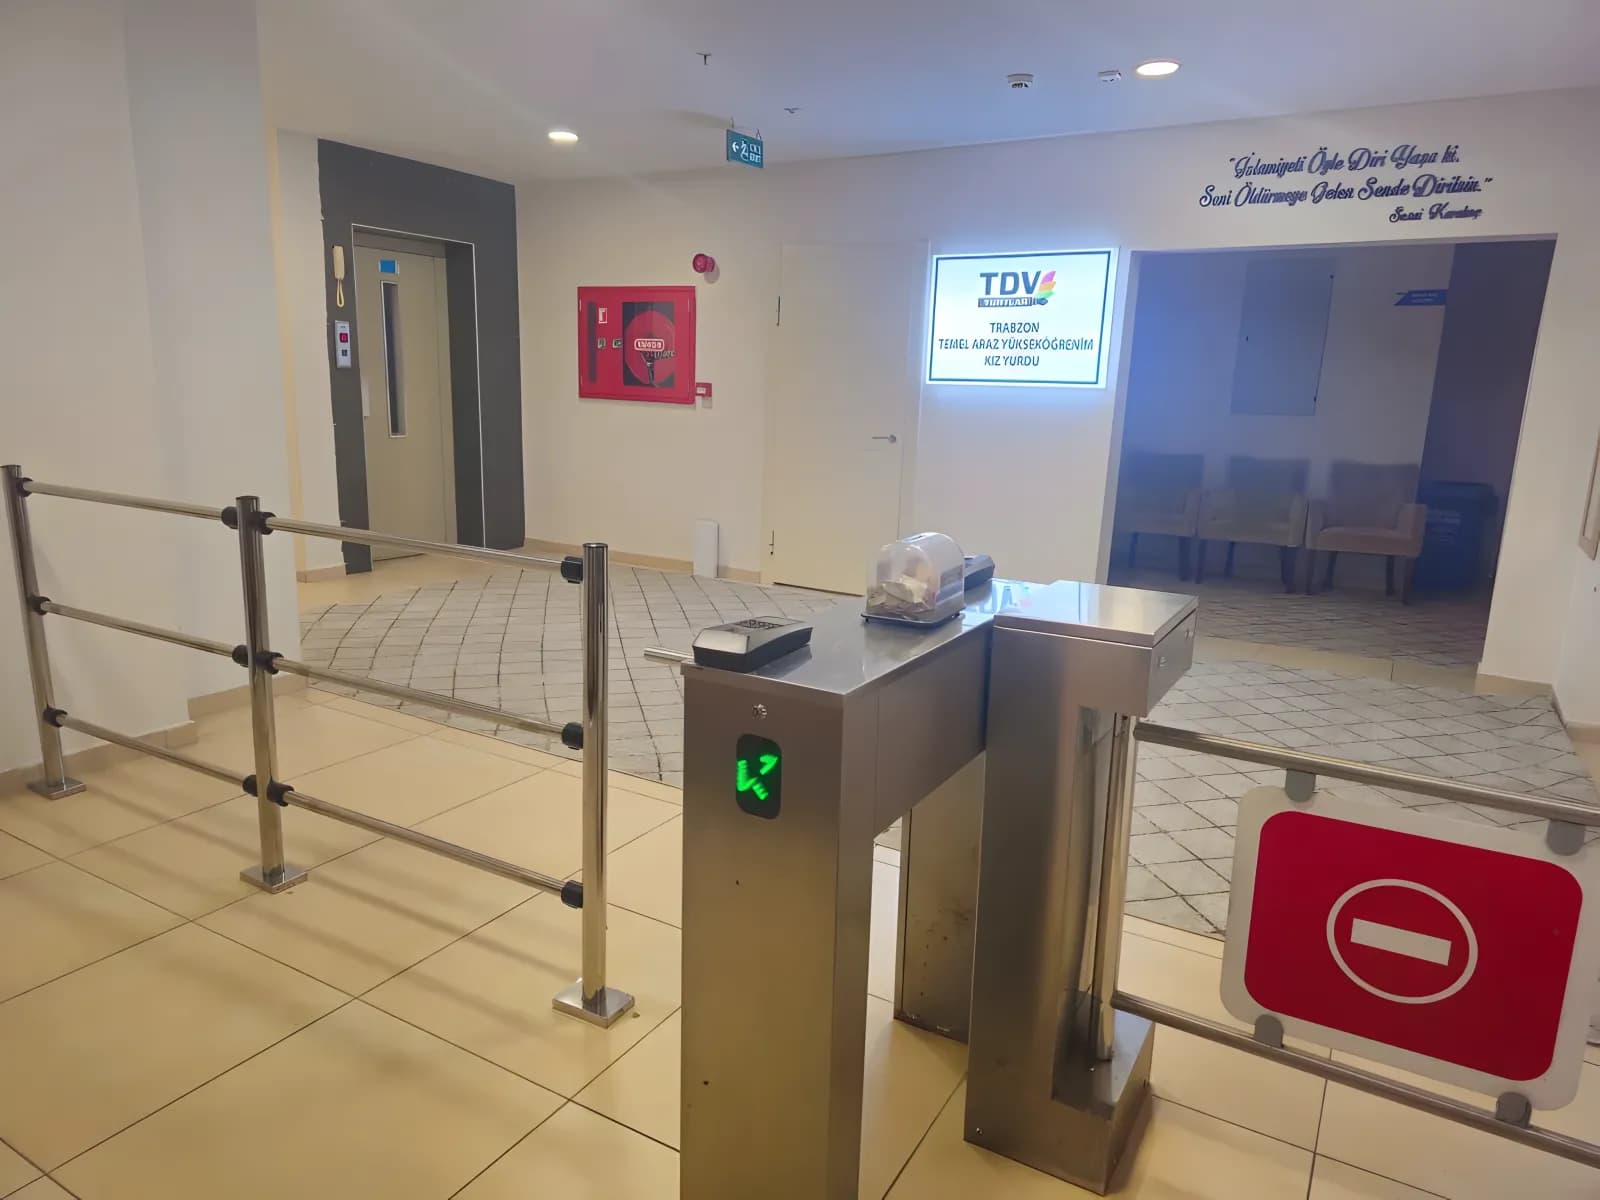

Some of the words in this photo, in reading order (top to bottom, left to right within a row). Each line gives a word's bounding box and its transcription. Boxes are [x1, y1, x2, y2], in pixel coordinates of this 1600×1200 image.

[1348, 147, 1388, 171] Diri
[1310, 181, 1354, 204] Gelen
[1357, 176, 1411, 201] Sende
[979, 270, 1042, 296] TDV
[989, 322, 1040, 333] TRABZON
[938, 338, 970, 350] TEMEL
[972, 338, 999, 350] ARAZ
[1002, 336, 1094, 351] YÜKSEKÖĞRENİM
[984, 355, 1001, 367] KIZ
[1003, 355, 1040, 367] YURDU
